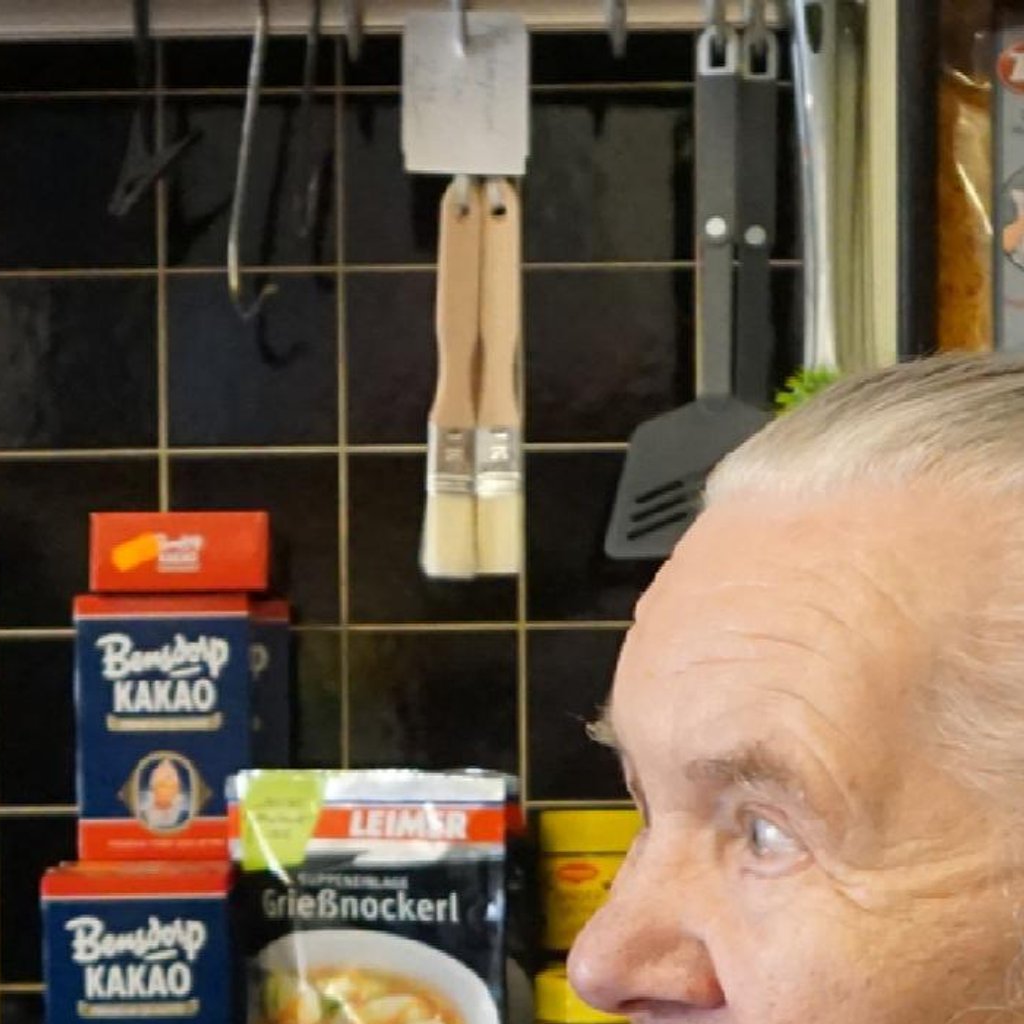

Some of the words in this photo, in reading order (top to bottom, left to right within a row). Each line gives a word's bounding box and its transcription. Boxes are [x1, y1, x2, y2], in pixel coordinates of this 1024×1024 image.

[114, 679, 216, 713] KAKAO
[262, 888, 460, 922] Grießnockerl
[84, 962, 192, 998] KAKAO
